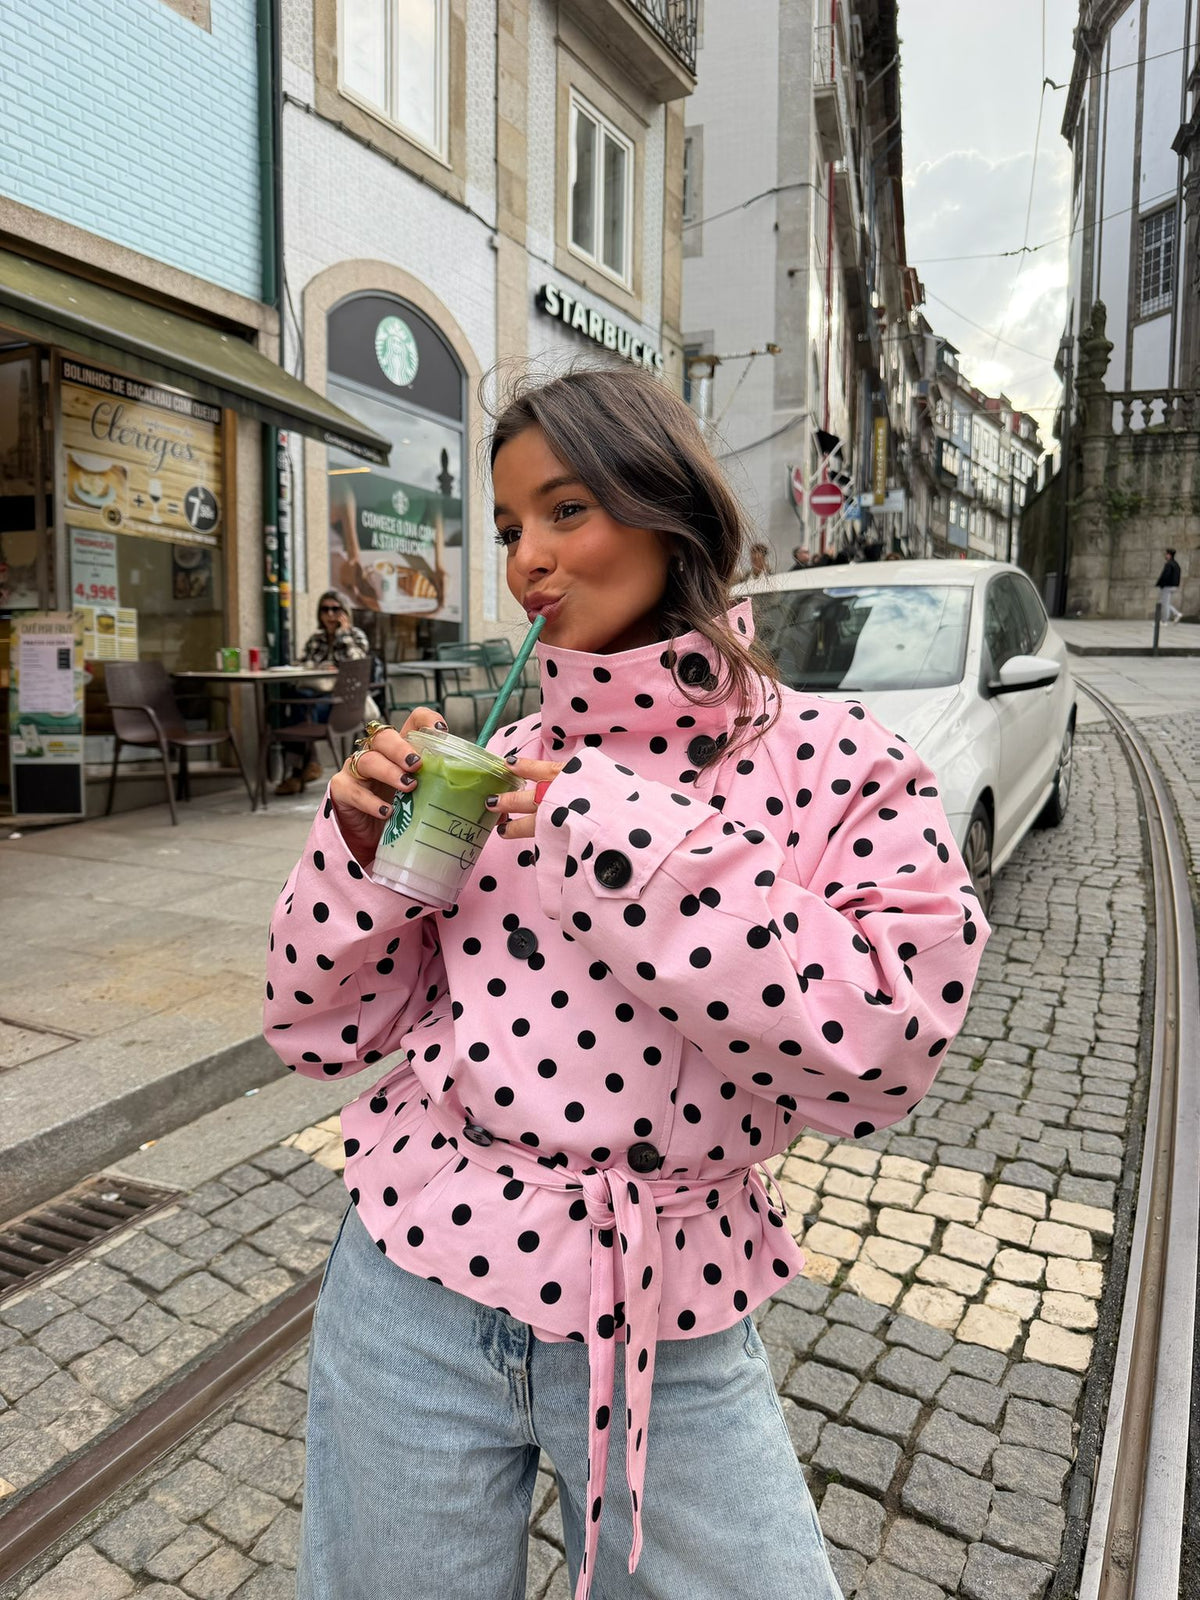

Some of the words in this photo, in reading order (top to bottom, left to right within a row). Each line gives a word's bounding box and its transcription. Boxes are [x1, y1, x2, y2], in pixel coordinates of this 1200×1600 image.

[545, 283, 664, 378] STARBUCKS
[63, 362, 112, 391] BOLINHOS
[112, 377, 125, 394] DE
[126, 381, 172, 411] BACALHAU
[172, 395, 192, 415] COM
[74, 582, 117, 601] 4,99€
